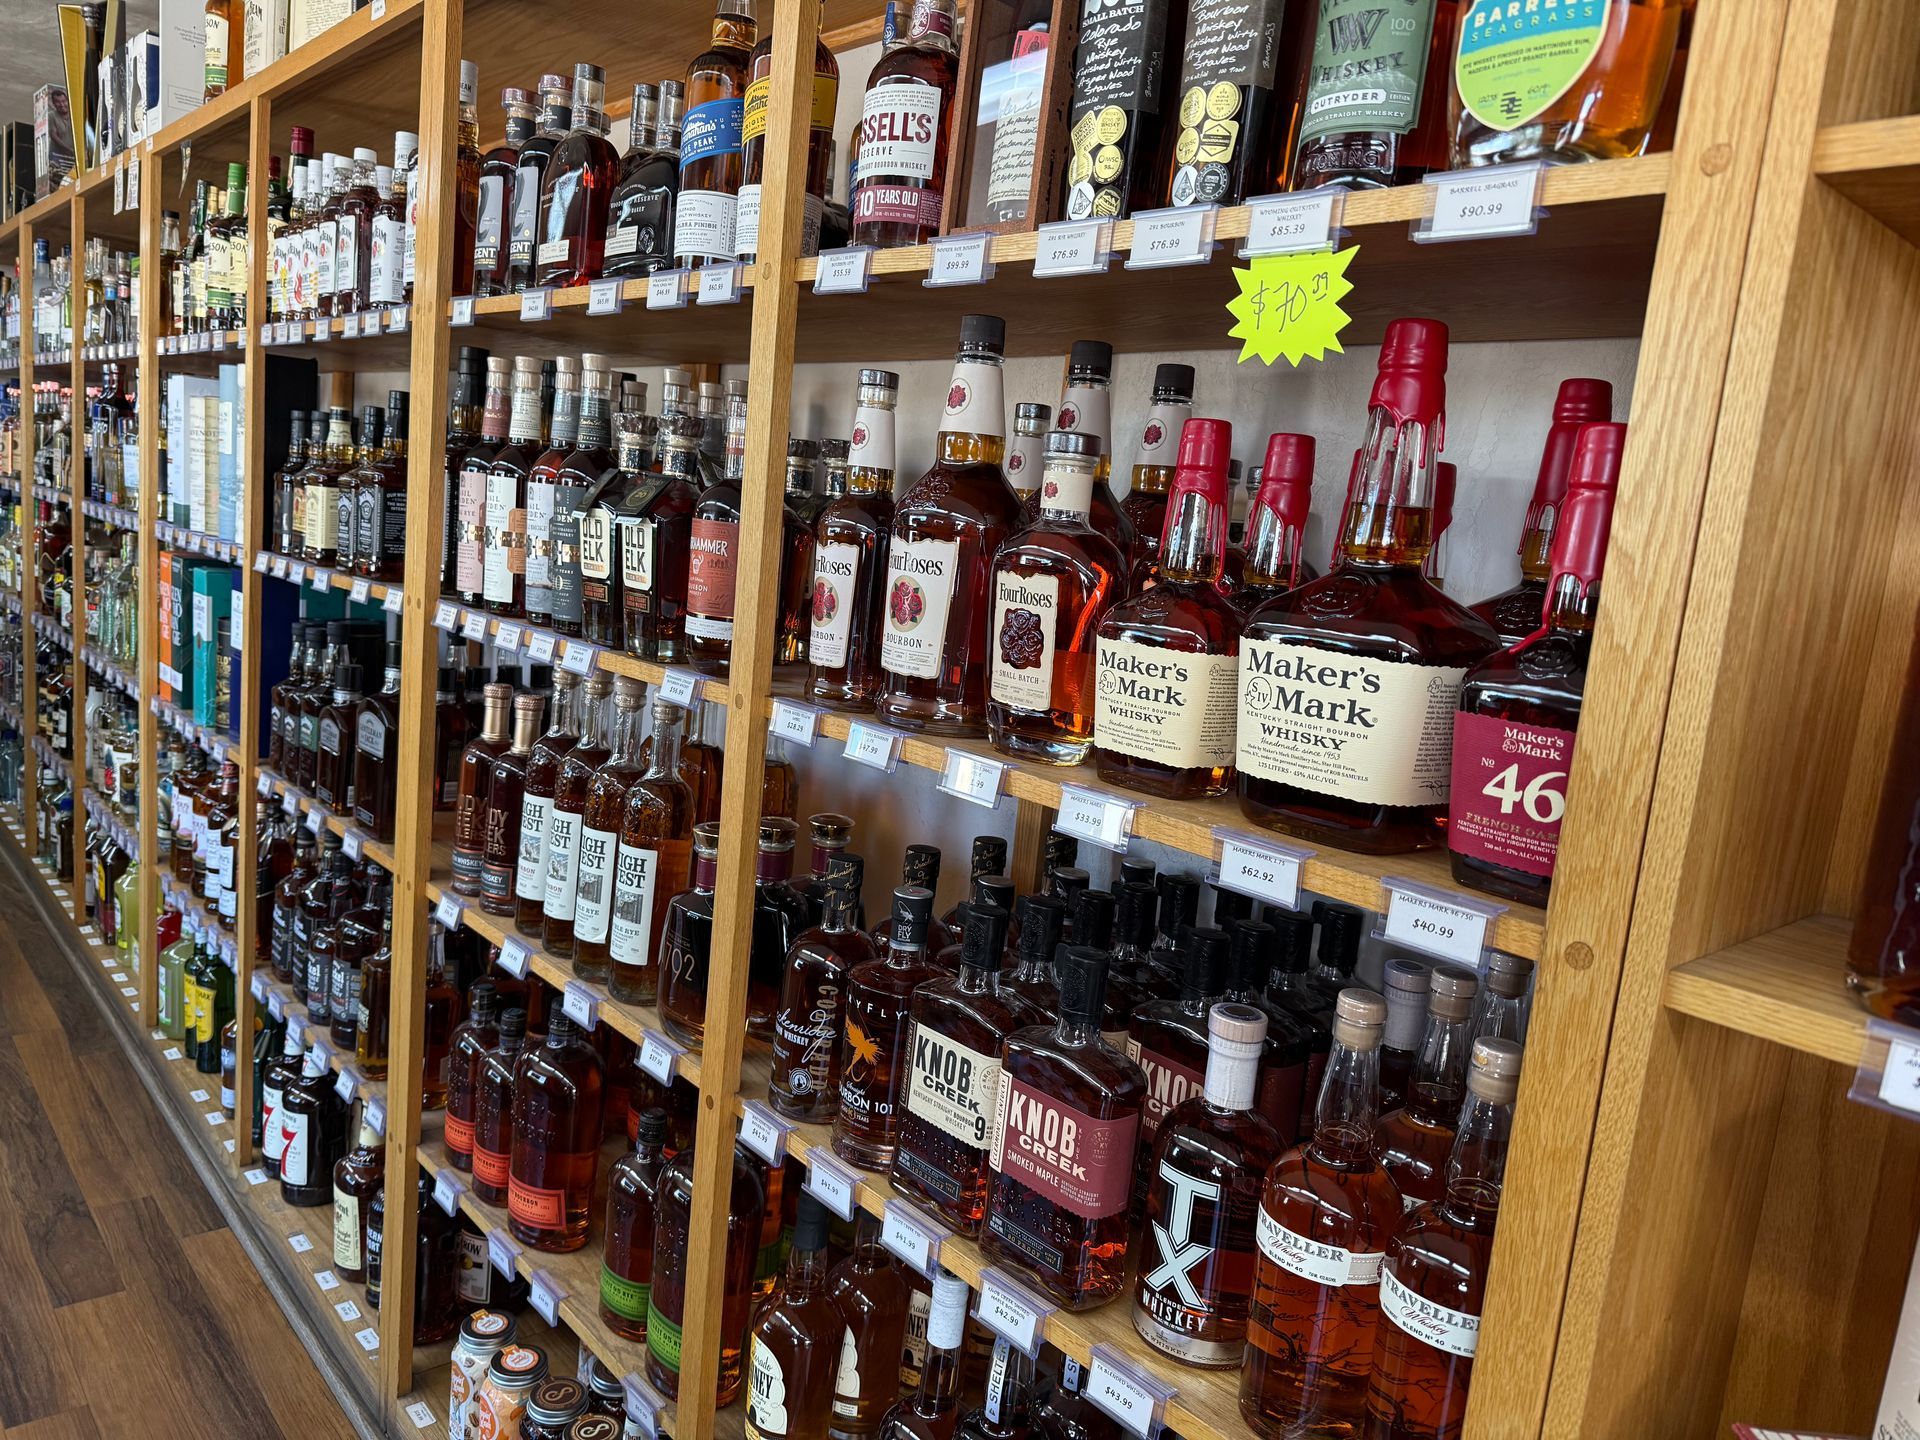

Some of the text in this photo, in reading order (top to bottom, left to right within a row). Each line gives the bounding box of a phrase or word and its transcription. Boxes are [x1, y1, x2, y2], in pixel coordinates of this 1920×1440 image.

[1083, 5, 1144, 28] SMALL BATCH
[1195, 5, 1249, 24] Bourbon
[1391, 18, 1416, 30] 100
[1471, 6, 1593, 43] SEAGRASS
[1081, 15, 1141, 44] Colorado
[1196, 19, 1243, 37] Whiskey
[1094, 38, 1118, 50] Rye
[1185, 29, 1258, 52] Finished with
[1187, 39, 1251, 62] Aspen Wood
[1533, 40, 1572, 52] MARTINIQUE
[1086, 47, 1127, 65] Whiskey
[1193, 56, 1236, 70] Staves
[1549, 48, 1579, 58] BARRELS
[1076, 57, 1142, 79] Finished with
[1077, 66, 1136, 89] Aspen Wood
[1311, 52, 1408, 86] WHISKEY
[1084, 82, 1122, 95] Staves
[1389, 93, 1411, 101] EDITION
[1313, 92, 1379, 110] OUTRYDER
[1324, 110, 1362, 121] STRAIGHT
[900, 160, 927, 171] WHISKEY
[1450, 180, 1518, 195] BARRELL SEAGRASS
[860, 190, 873, 216] 10
[876, 189, 900, 205] YEARS
[902, 190, 918, 206] OLD
[1260, 206, 1288, 215] WYOMING
[1459, 203, 1502, 217] $90.99
[1270, 224, 1305, 236] $85.39
[1051, 249, 1079, 260] $76.99
[1150, 238, 1180, 250] $76.99
[582, 517, 603, 539] OLD
[624, 525, 645, 549] OLD
[583, 542, 604, 562] ELK
[625, 549, 646, 573] ELK
[886, 632, 922, 648] BOURBON
[1100, 648, 1188, 682] Maker's
[1247, 647, 1380, 693] Maker's
[999, 669, 1039, 685] SMALL BATCH
[1116, 676, 1185, 707] Mark
[1100, 695, 1181, 717] KENTUCKY STRAIGHT BOURBON
[1109, 704, 1166, 725] WHISKY
[1272, 686, 1375, 728] Mark
[1247, 710, 1368, 740] KENTUCKY STRAIGHT BOURBON
[1260, 723, 1347, 751] WHISKY
[1260, 736, 1340, 760] Handmade since 1953
[1503, 727, 1564, 747] Maker's
[1517, 743, 1562, 760] Mark
[1268, 764, 1289, 773] LITERS
[1293, 770, 1306, 779] 45%
[1306, 773, 1340, 786] ALC./VOL.
[1341, 772, 1369, 782] SAMUELS
[1070, 794, 1089, 807] MAKERS
[1482, 763, 1566, 823] 46
[1074, 812, 1101, 827] $33.99
[1465, 812, 1559, 841] FRENCH OAK
[1457, 820, 1539, 846] KENTUCKY STRAIGHT BOURBON
[1457, 825, 1550, 853] FINISHED WITH VIRGIN FRENCH
[619, 853, 647, 874] IGH
[1232, 845, 1285, 867] MAKERS MARK 1.75
[618, 870, 645, 889] EST
[1240, 865, 1274, 883] $62.92
[1399, 895, 1473, 921] MAKERS MARK 750
[625, 928, 640, 937] RYE
[898, 925, 912, 934] DRY
[898, 931, 912, 940] FLY
[1412, 918, 1454, 938] $40.99
[784, 1031, 809, 1047] WHISKEY
[915, 1034, 972, 1094] KNOB
[923, 1075, 981, 1115] CREEK
[856, 1114, 869, 1123] YEARS
[875, 1101, 893, 1115] 101
[913, 1089, 975, 1128] KENTUCKY STRAIGHT BOURBON
[945, 1115, 966, 1131] WHISKEY
[974, 1116, 986, 1142] 9
[1010, 1090, 1077, 1158] KNOB
[281, 1125, 297, 1177] 7
[1019, 1134, 1088, 1182] CREEK
[912, 1166, 923, 1177] 100
[1007, 1150, 1059, 1188] SMOKED MAPLE
[1258, 1206, 1344, 1263] TRAVELLER
[1017, 1239, 1040, 1258] PROOF
[1268, 1235, 1308, 1263] Whiskey
[1269, 1249, 1304, 1273] BLEND 40
[1004, 1302, 1026, 1320] BOURBON
[1142, 1288, 1206, 1333] WHISKEY
[1155, 1292, 1187, 1312] BLENDED
[994, 1305, 1019, 1327] $42.99
[1400, 1305, 1449, 1335] Whiskey
[1150, 1333, 1188, 1357] WHISKEY
[1402, 1321, 1445, 1347] BLEND 40
[989, 1343, 1008, 1404] SHELTER
[1104, 1368, 1146, 1400] BLENDED WHISKEY
[1104, 1386, 1133, 1410] $43.99
